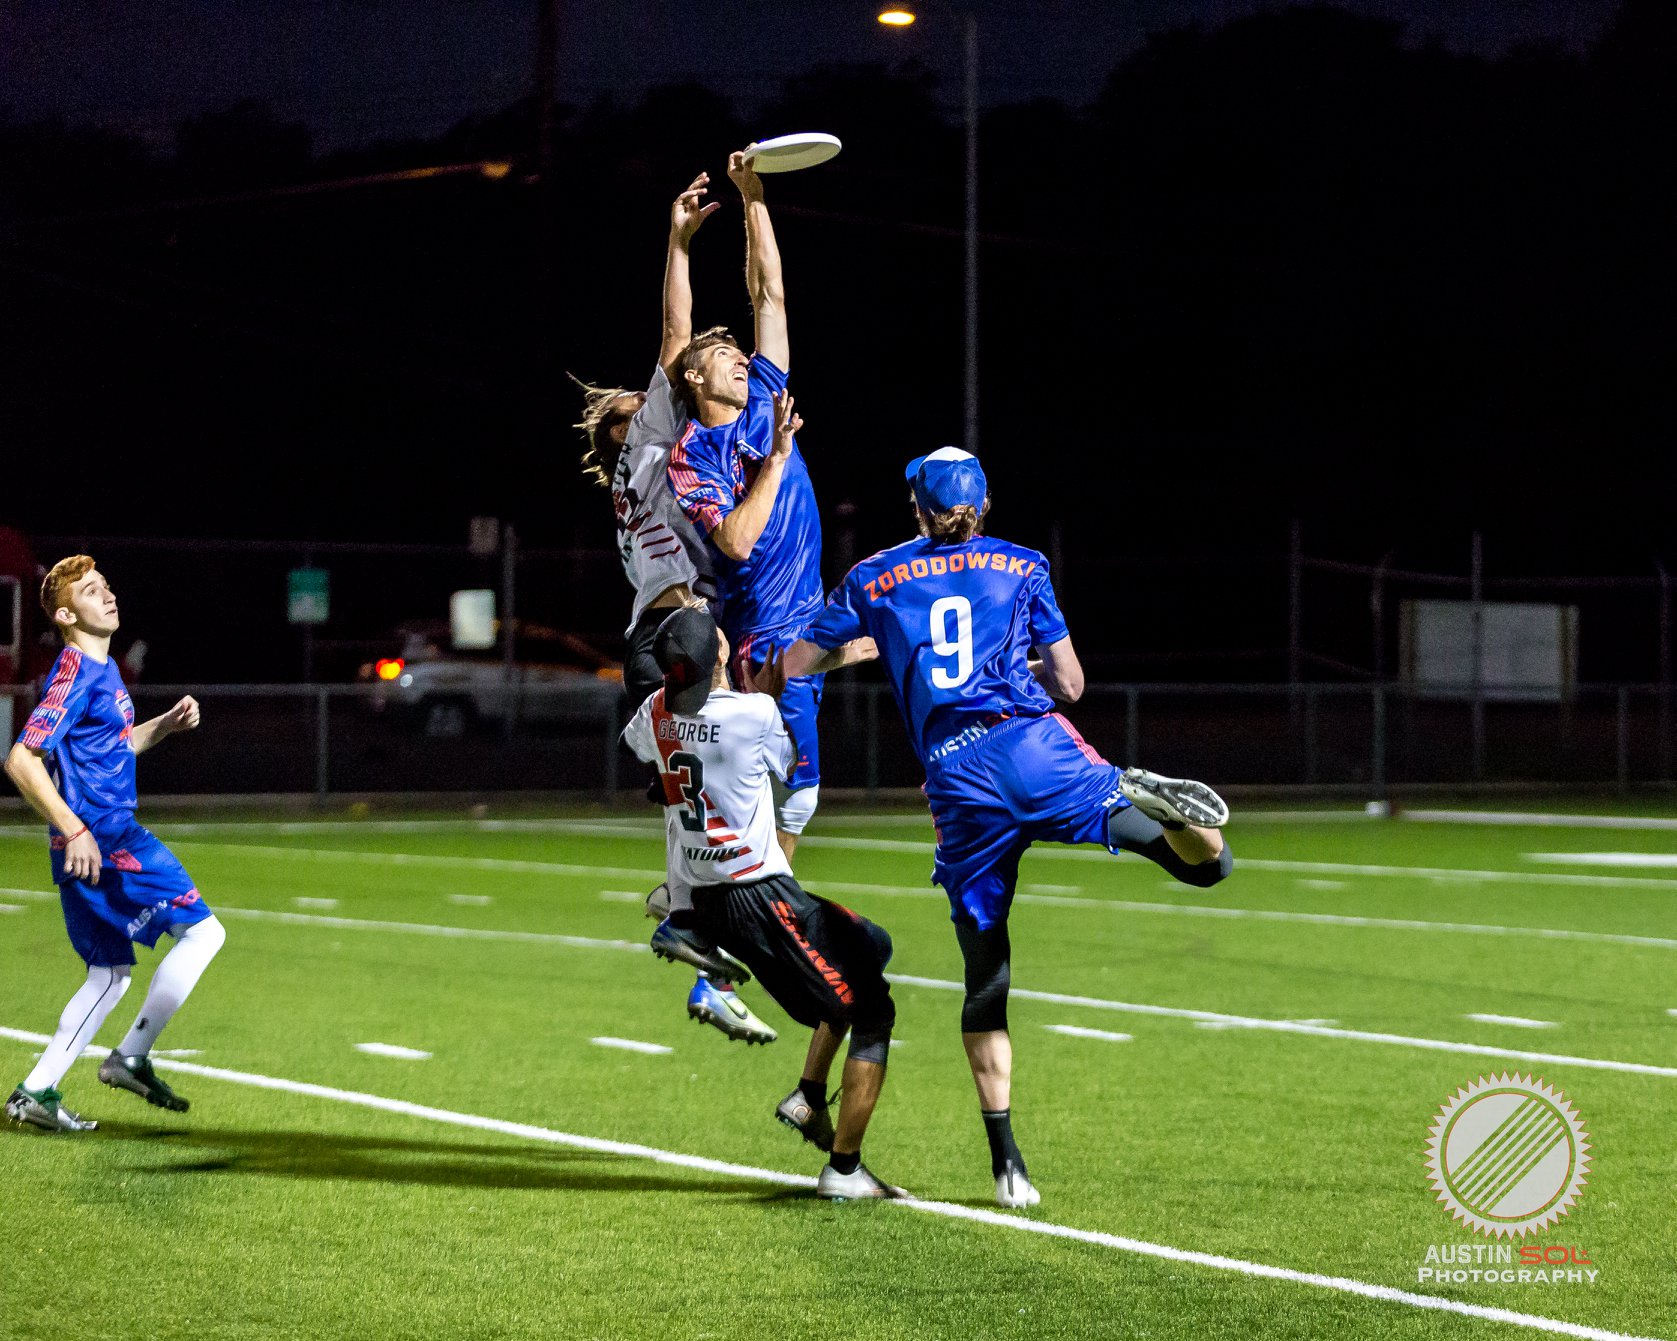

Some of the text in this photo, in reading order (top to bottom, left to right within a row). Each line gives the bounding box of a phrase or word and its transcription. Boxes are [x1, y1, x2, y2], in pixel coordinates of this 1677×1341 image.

[863, 552, 1036, 602] ZDRODOWSKI
[929, 595, 974, 689] 9
[658, 719, 721, 744] GEORGE
[667, 750, 706, 833] 3
